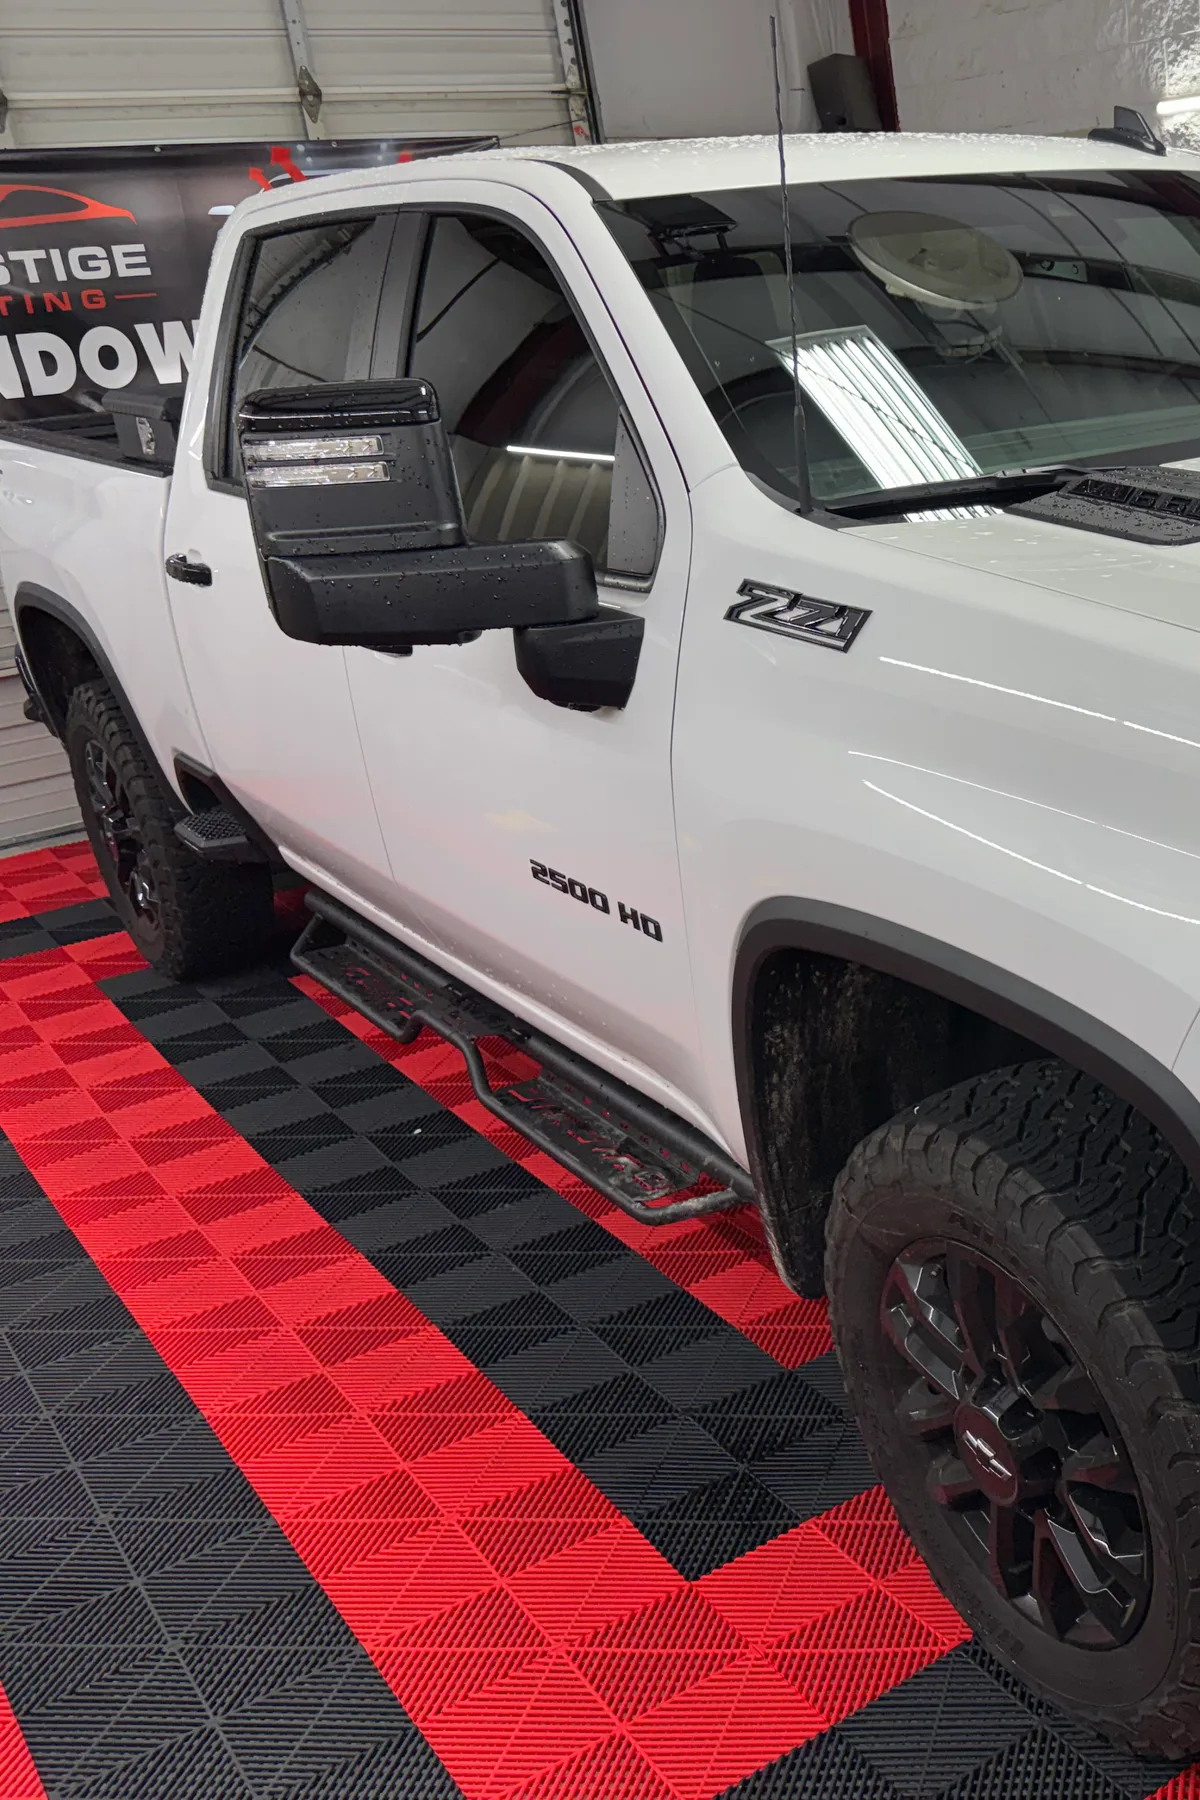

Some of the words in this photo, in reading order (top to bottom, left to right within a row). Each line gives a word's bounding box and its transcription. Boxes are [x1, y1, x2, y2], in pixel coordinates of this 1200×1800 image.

[0, 243, 152, 286] TIGE
[723, 578, 873, 653] Z71
[529, 858, 611, 915] 2500
[617, 901, 663, 943] HD
